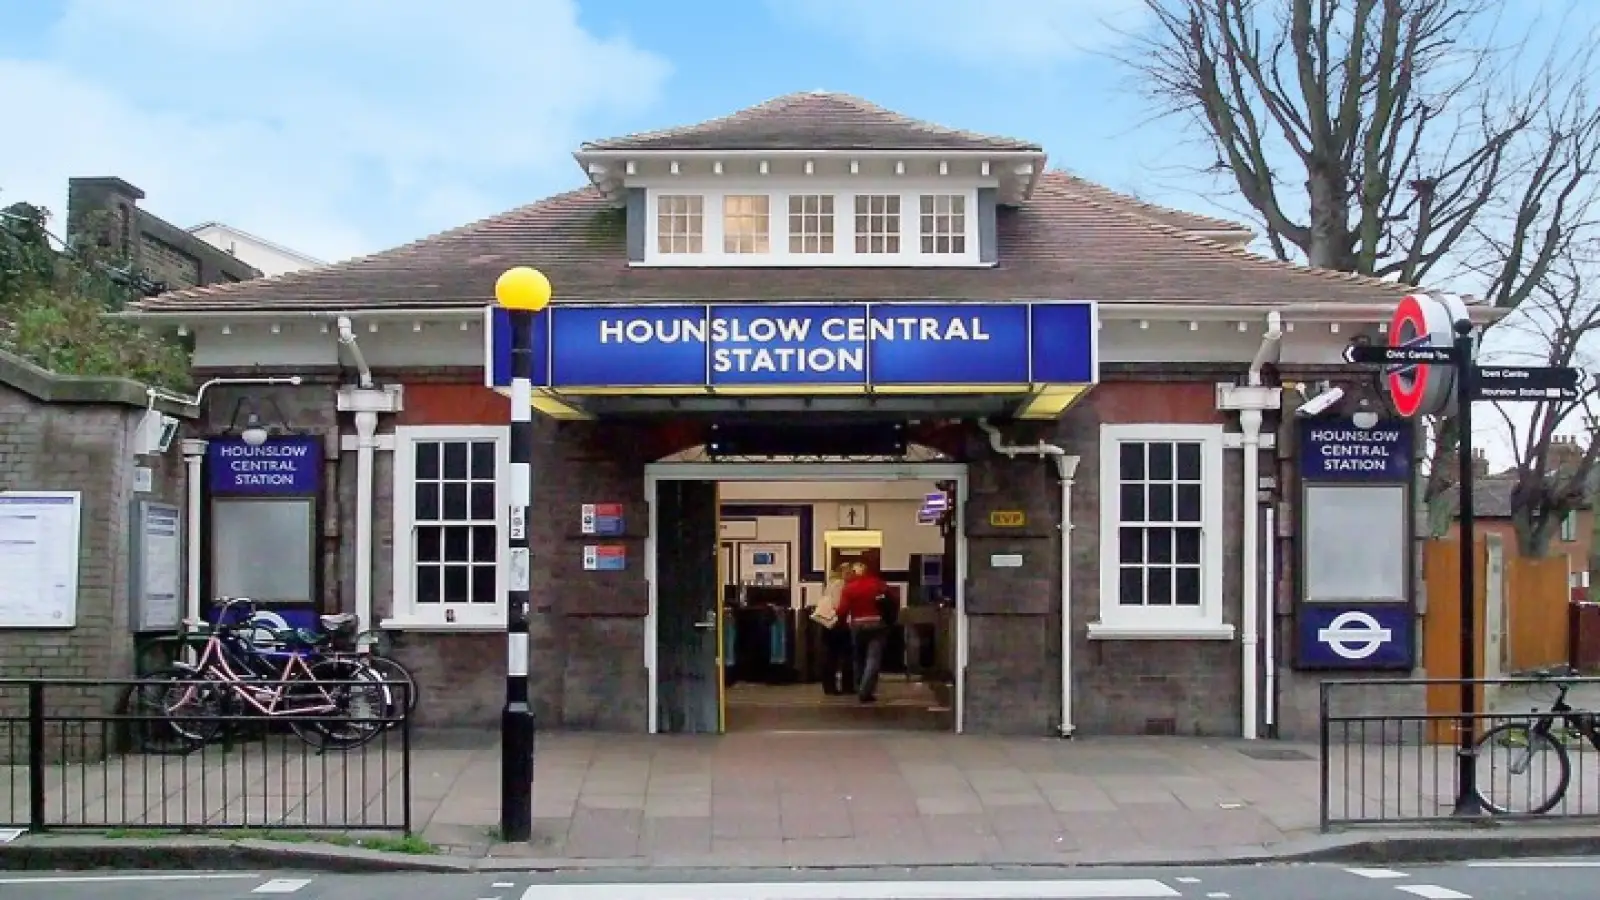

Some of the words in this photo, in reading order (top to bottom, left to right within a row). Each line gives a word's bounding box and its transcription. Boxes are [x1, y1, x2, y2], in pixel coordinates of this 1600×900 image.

[600, 317, 811, 343] HOUNSLOW
[821, 316, 990, 342] CENTRAL
[713, 347, 863, 372] STATION
[1310, 430, 1399, 441] HOUNSLOW
[221, 445, 308, 457] HOUNSLOW
[1321, 444, 1390, 456] CENTRAL
[230, 460, 298, 471] CENTRAL
[1323, 459, 1386, 470] STATION
[234, 473, 294, 485] STATION
